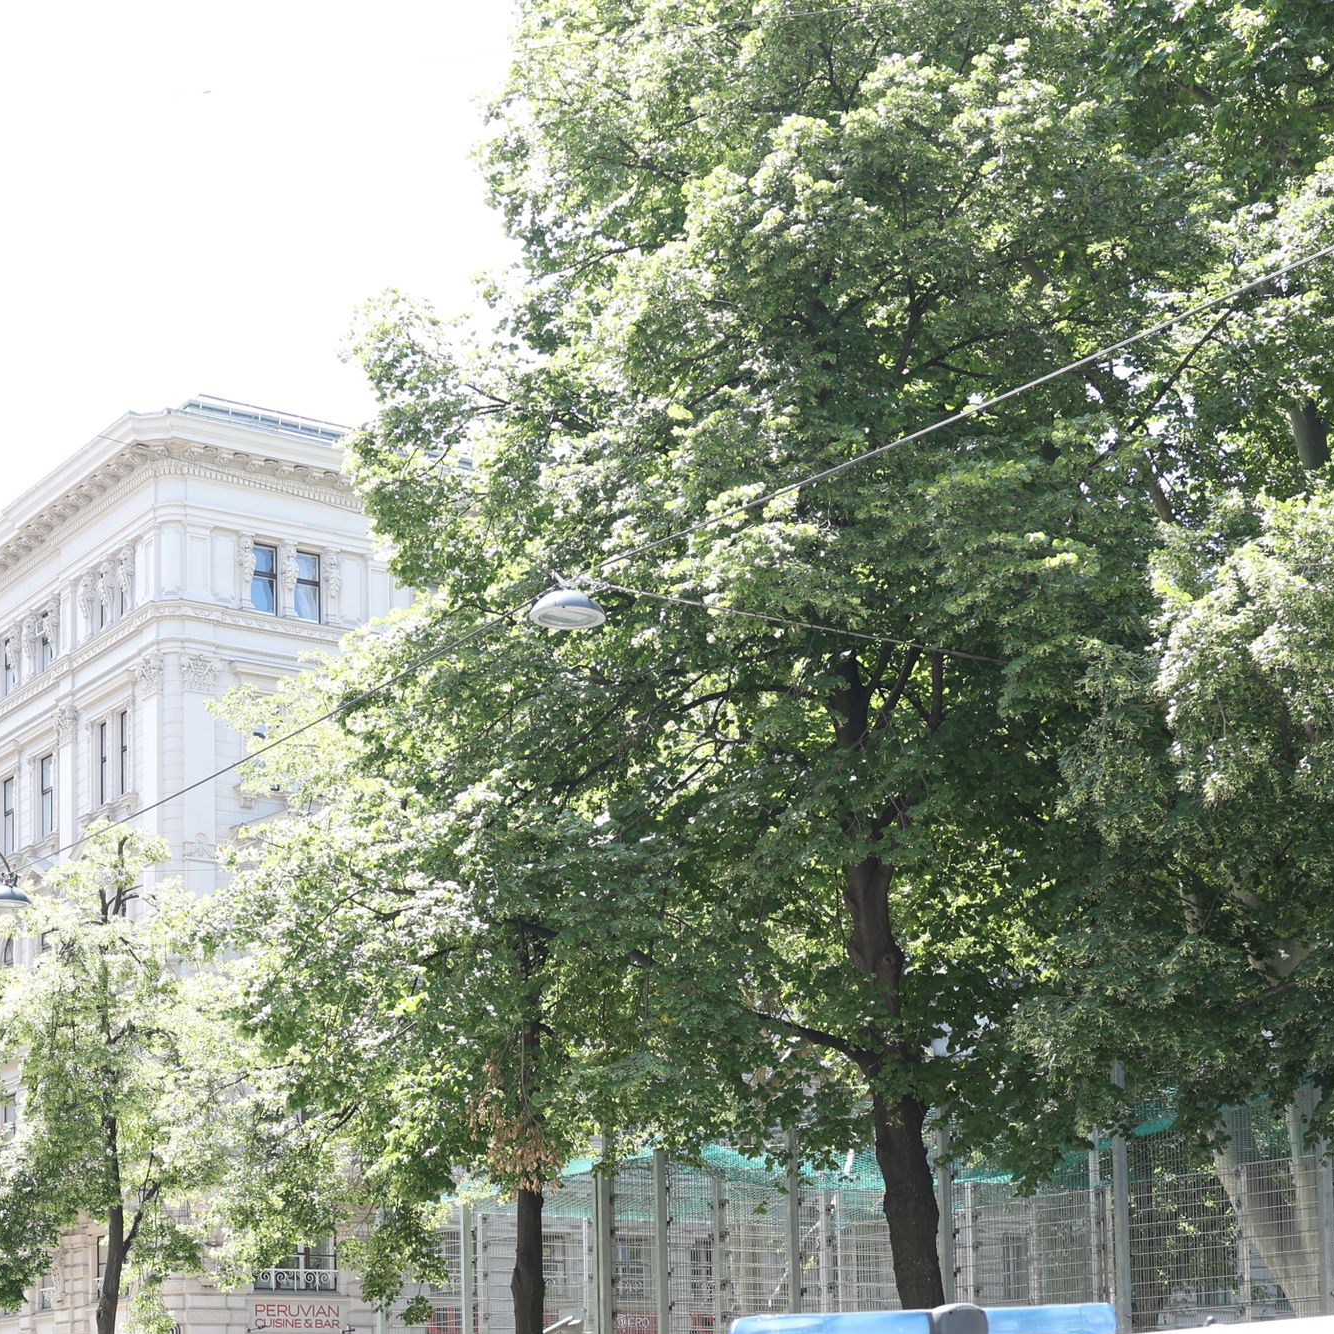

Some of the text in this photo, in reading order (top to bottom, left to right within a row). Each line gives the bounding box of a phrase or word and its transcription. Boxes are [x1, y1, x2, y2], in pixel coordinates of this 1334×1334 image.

[254, 1304, 340, 1318] PERUVIAN
[254, 1318, 340, 1329] CUISINE & BAR
